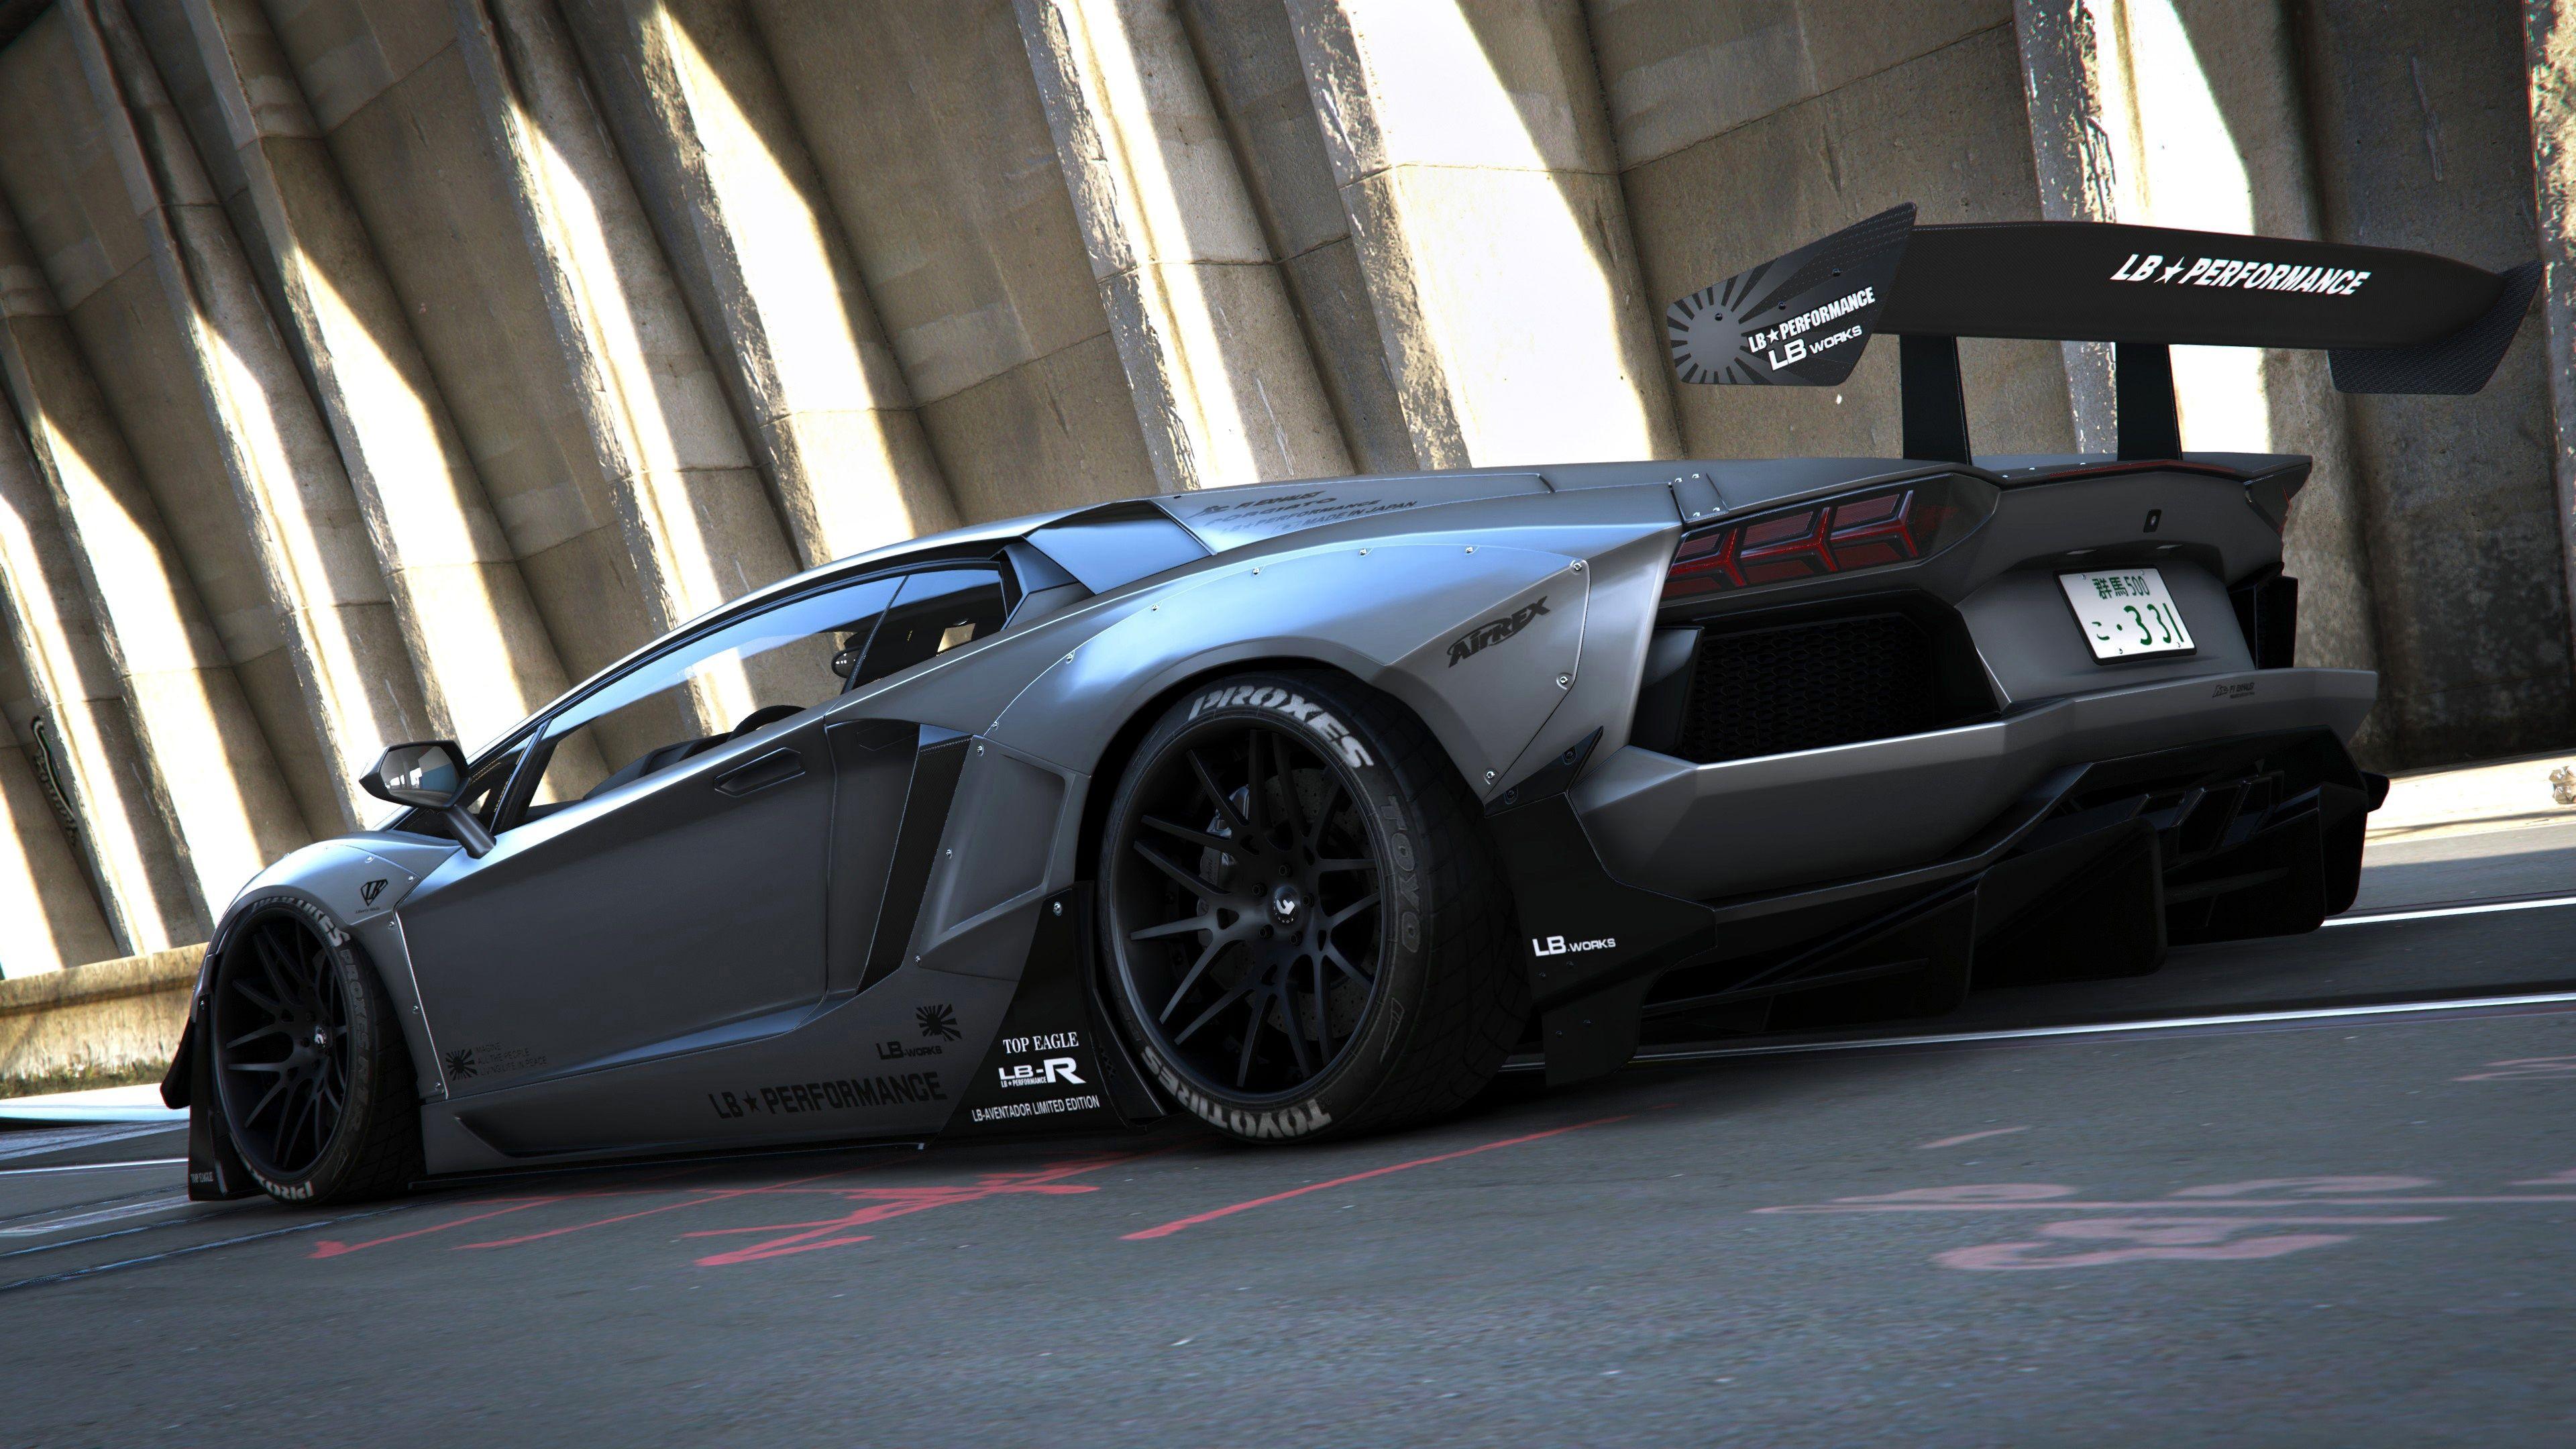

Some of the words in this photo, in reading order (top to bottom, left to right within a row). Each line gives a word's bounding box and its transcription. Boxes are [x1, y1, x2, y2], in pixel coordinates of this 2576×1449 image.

[2110, 254, 2164, 281] LB
[2178, 258, 2372, 295] PERFORMANCE
[1748, 333, 1768, 354] LB
[1779, 286, 1876, 340] PERFORMANCE
[1809, 325, 1862, 354] WORKS
[1187, 685, 1375, 769] PROXES
[1002, 1037, 1030, 1054] TOP
[1032, 1032, 1079, 1051] EAGLE
[708, 1091, 744, 1120] LB
[762, 1071, 948, 1115] PERFORMANCE
[1012, 1076, 1047, 1087] PERFORMANCE
[971, 1103, 1032, 1122] LB-AVENTADOR
[1032, 1099, 1065, 1115] LIMITED
[1065, 1095, 1100, 1112] EDITION
